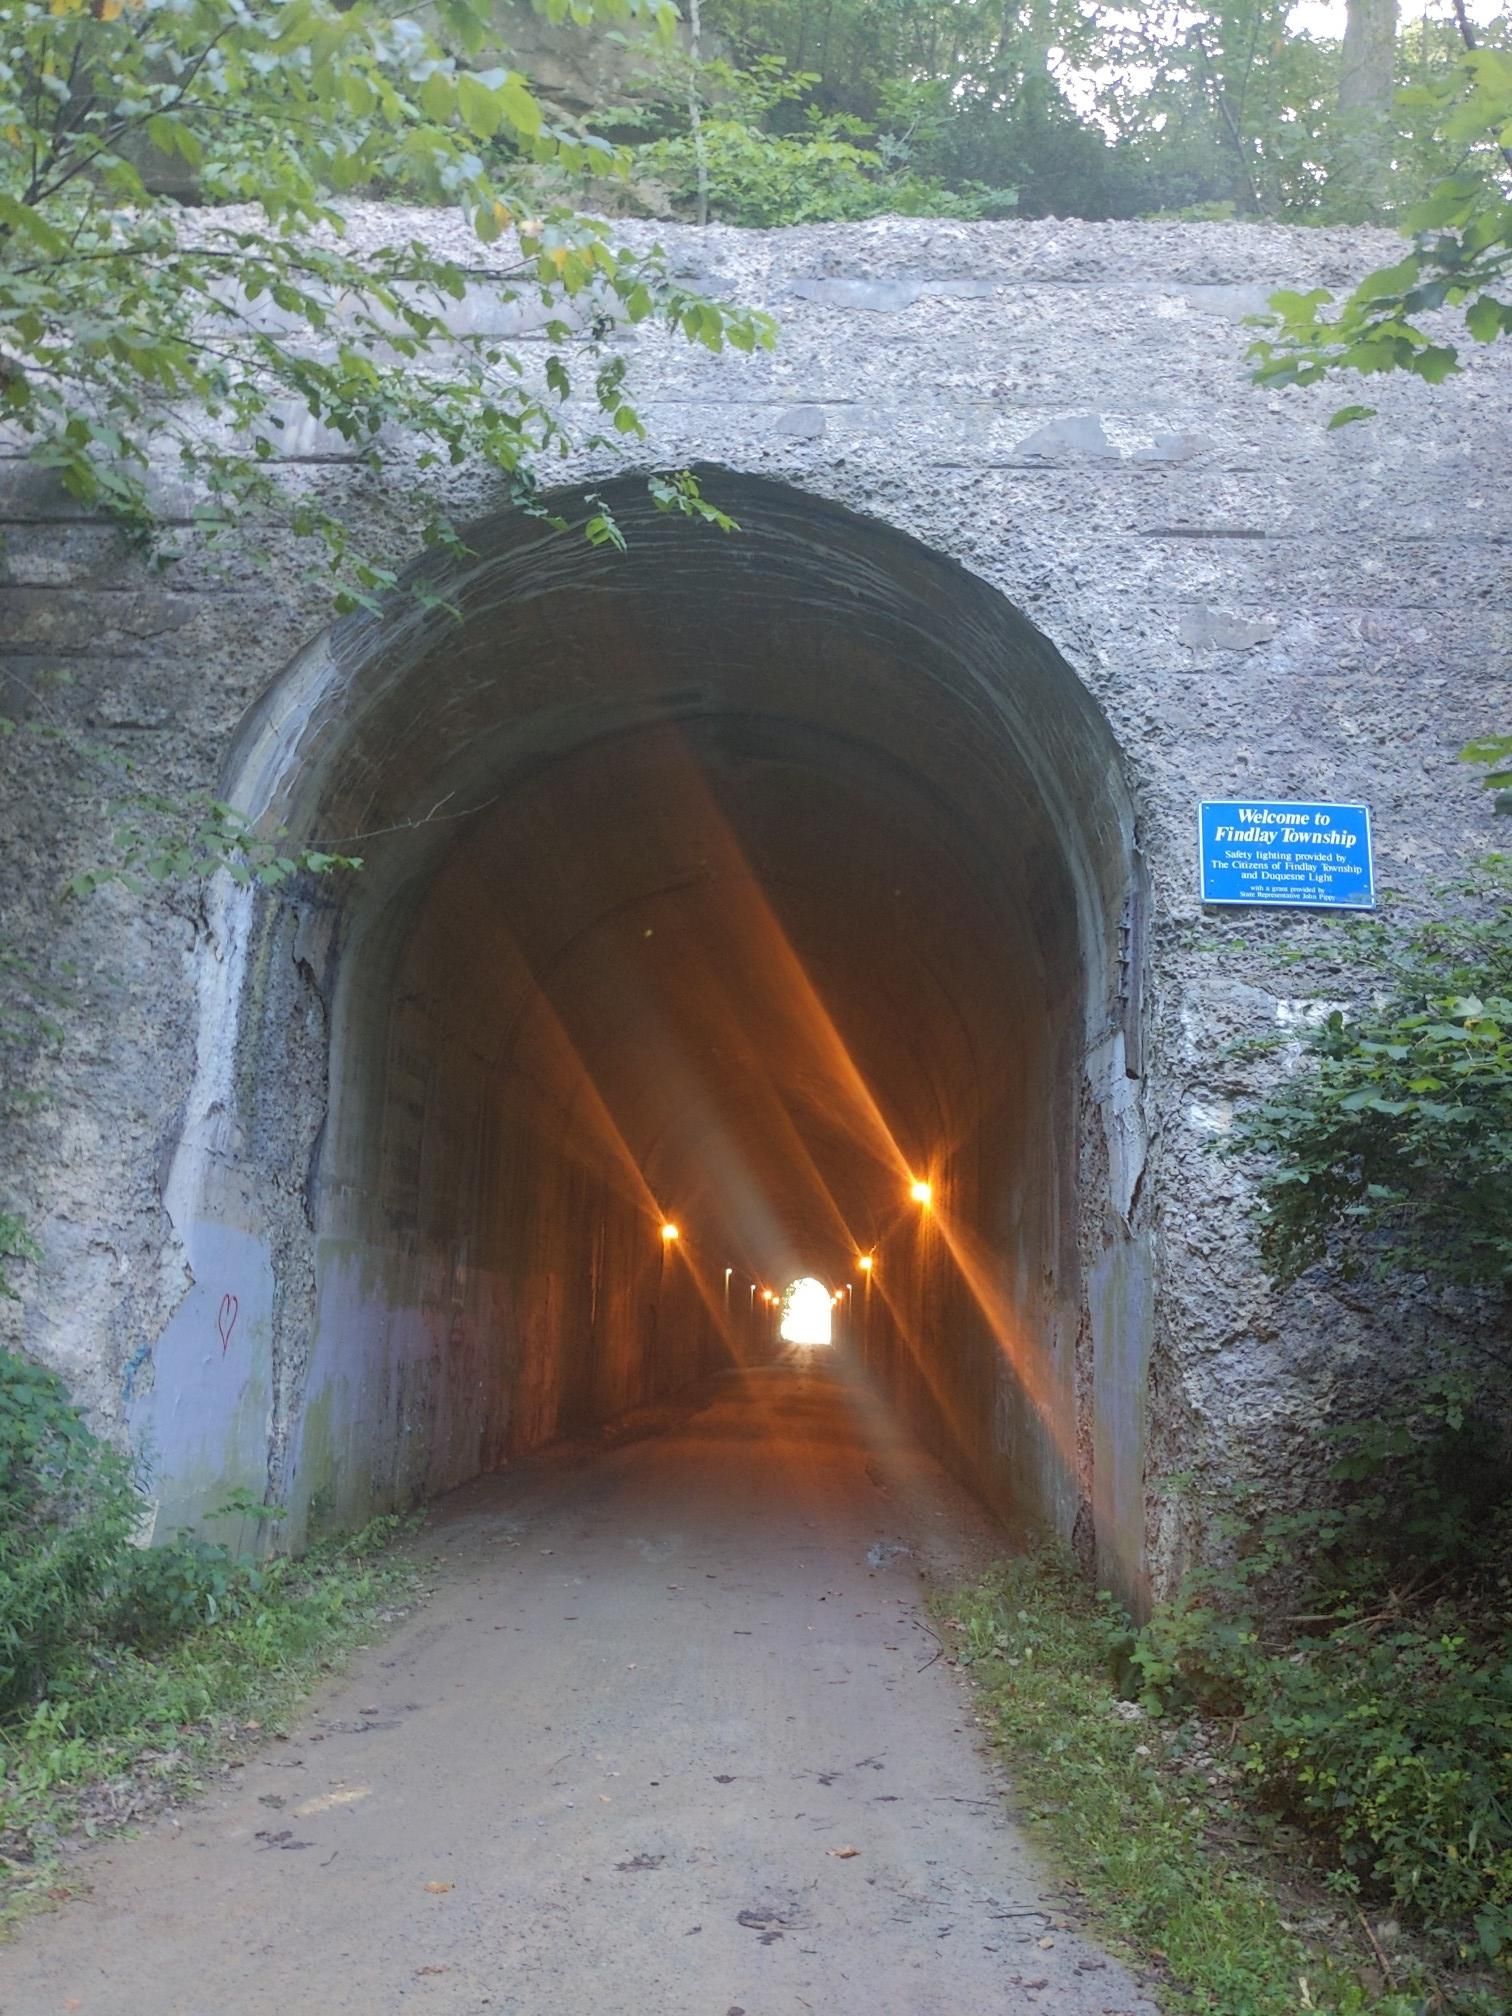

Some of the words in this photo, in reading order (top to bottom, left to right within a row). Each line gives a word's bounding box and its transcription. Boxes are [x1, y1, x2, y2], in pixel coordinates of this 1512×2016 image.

[1238, 808, 1310, 824] Welcome
[1315, 813, 1330, 825] to
[1215, 827, 1278, 844] Findlay
[1281, 828, 1357, 848] Township
[1225, 850, 1252, 859] Safety
[1256, 851, 1292, 861] lighting
[1296, 853, 1332, 862] provided
[1337, 854, 1346, 863] by
[1212, 860, 1228, 868] The
[1232, 861, 1268, 869] Citizens
[1285, 862, 1317, 872] Findlay
[1321, 864, 1362, 874] Township
[1262, 872, 1305, 881] Duquesne
[1309, 873, 1332, 882] Light
